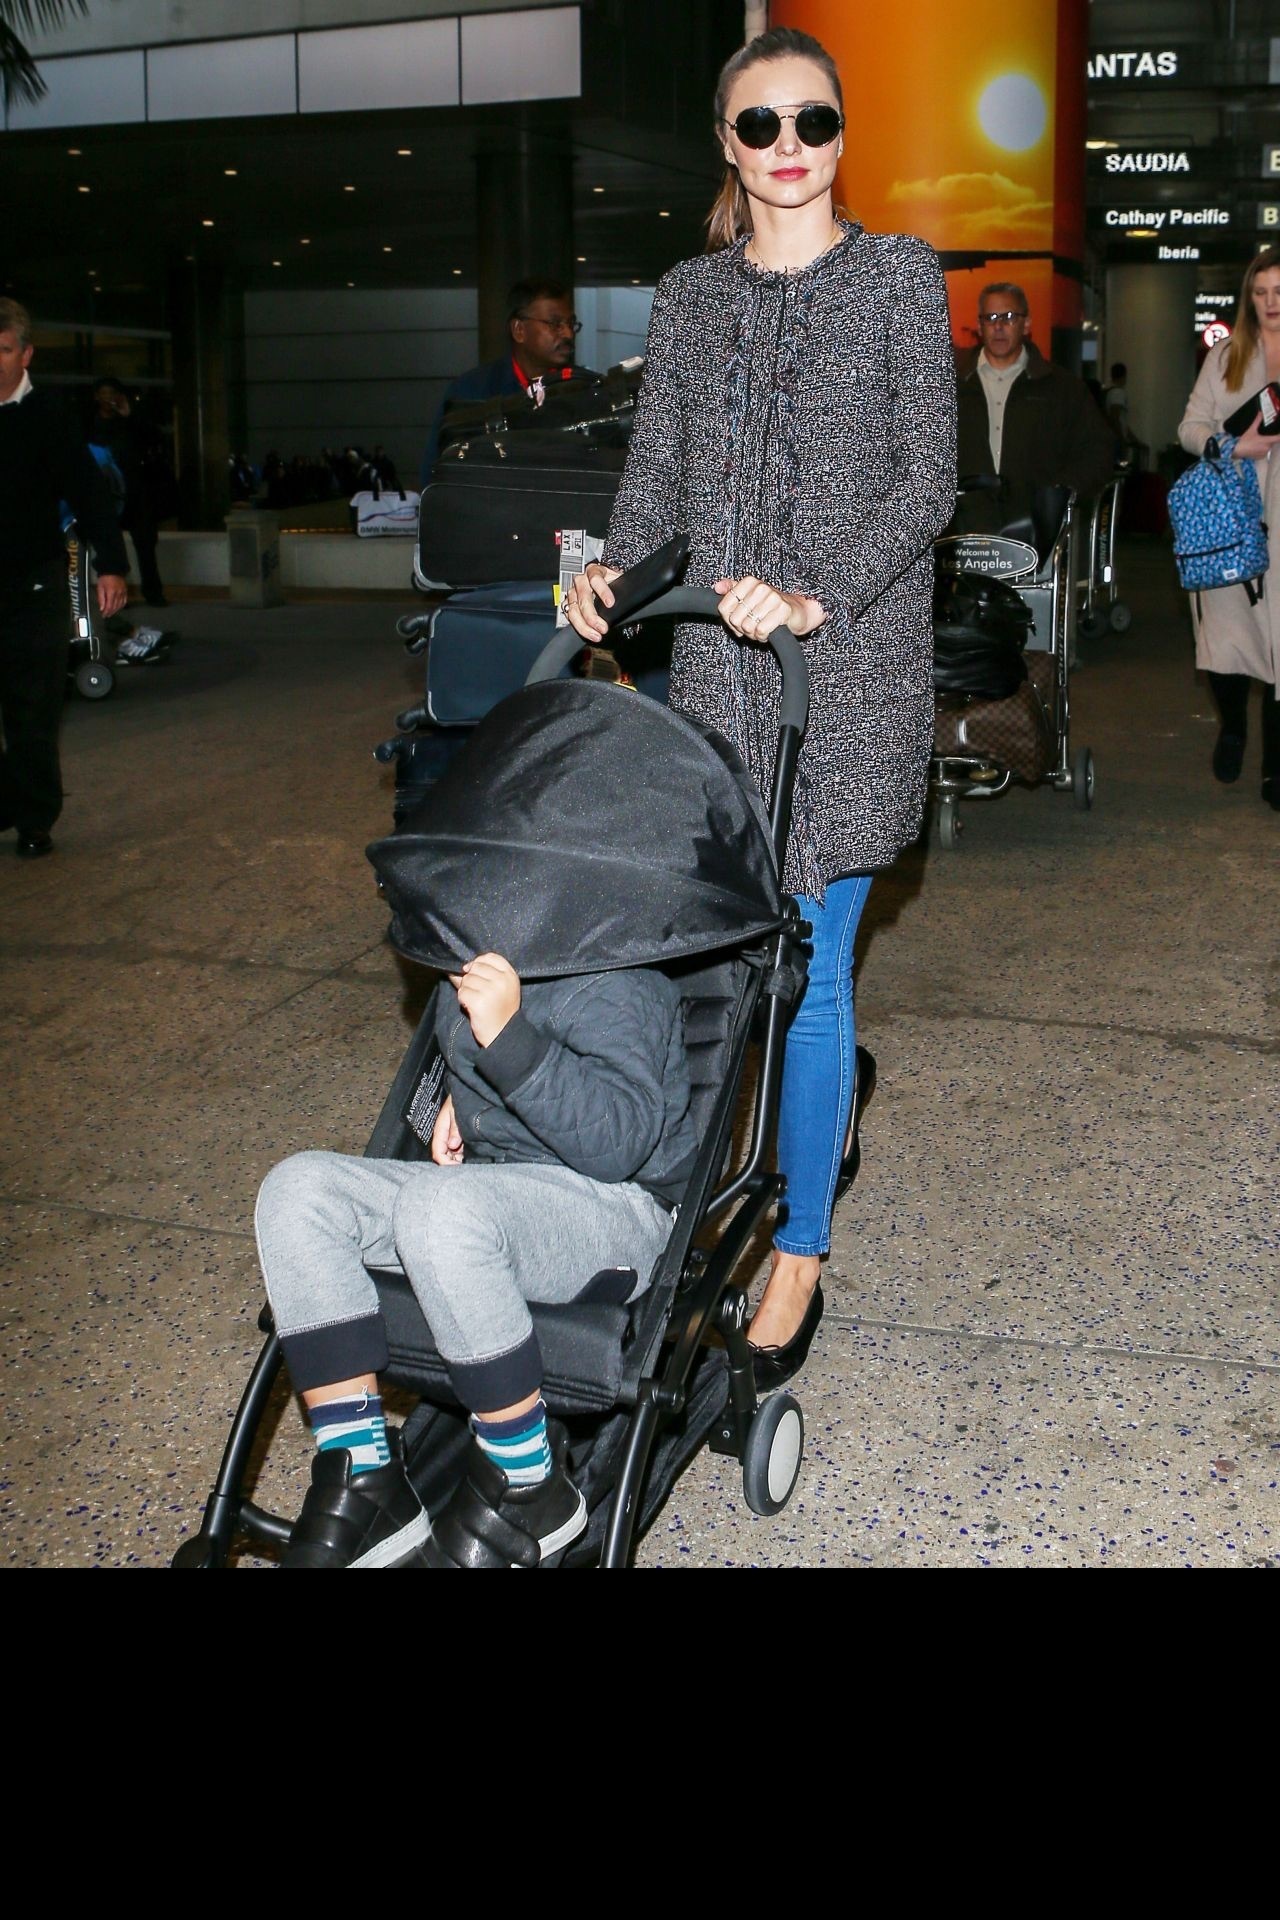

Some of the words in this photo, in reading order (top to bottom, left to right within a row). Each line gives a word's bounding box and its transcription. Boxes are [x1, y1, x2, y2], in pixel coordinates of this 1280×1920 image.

[1105, 152, 1190, 172] SAUDIA
[1105, 210, 1166, 228] Cathay
[1169, 208, 1229, 225] Pacific
[1263, 207, 1278, 225] B
[1158, 246, 1200, 259] Iberia
[563, 534, 571, 551] LAX
[955, 548, 990, 557] Welcome
[991, 549, 1000, 557] to
[964, 557, 1013, 571] Angeles
